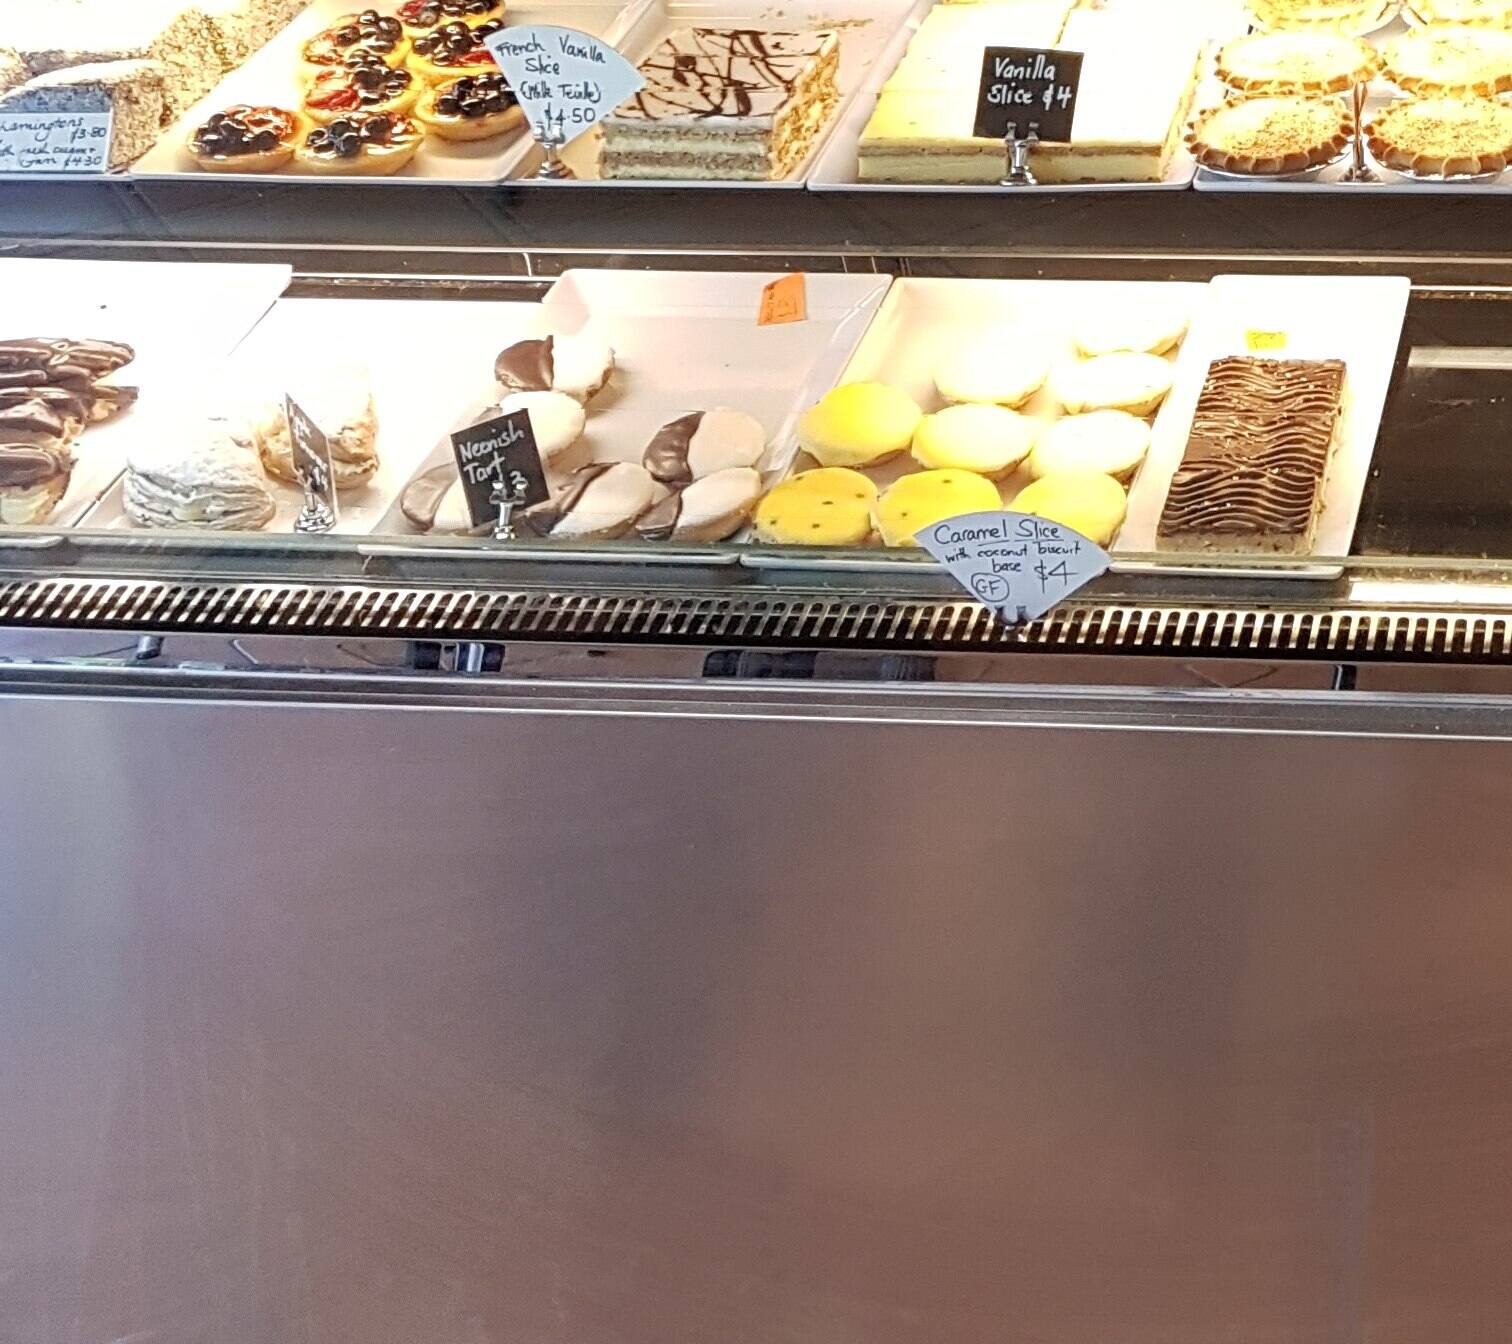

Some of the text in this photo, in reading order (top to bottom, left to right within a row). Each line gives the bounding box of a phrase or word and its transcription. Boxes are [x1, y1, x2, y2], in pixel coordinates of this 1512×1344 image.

[495, 33, 606, 64] French Vanilla
[524, 55, 560, 75] Slice
[995, 54, 1056, 81] Vanilla
[986, 82, 1072, 111] Slice $4
[459, 419, 525, 463] Neenish
[463, 450, 506, 484] Tart
[934, 519, 1062, 545] Caramel Slice
[945, 541, 1081, 564] with coconut biscuit
[991, 559, 1022, 574] base
[974, 559, 1079, 595] GF $4
